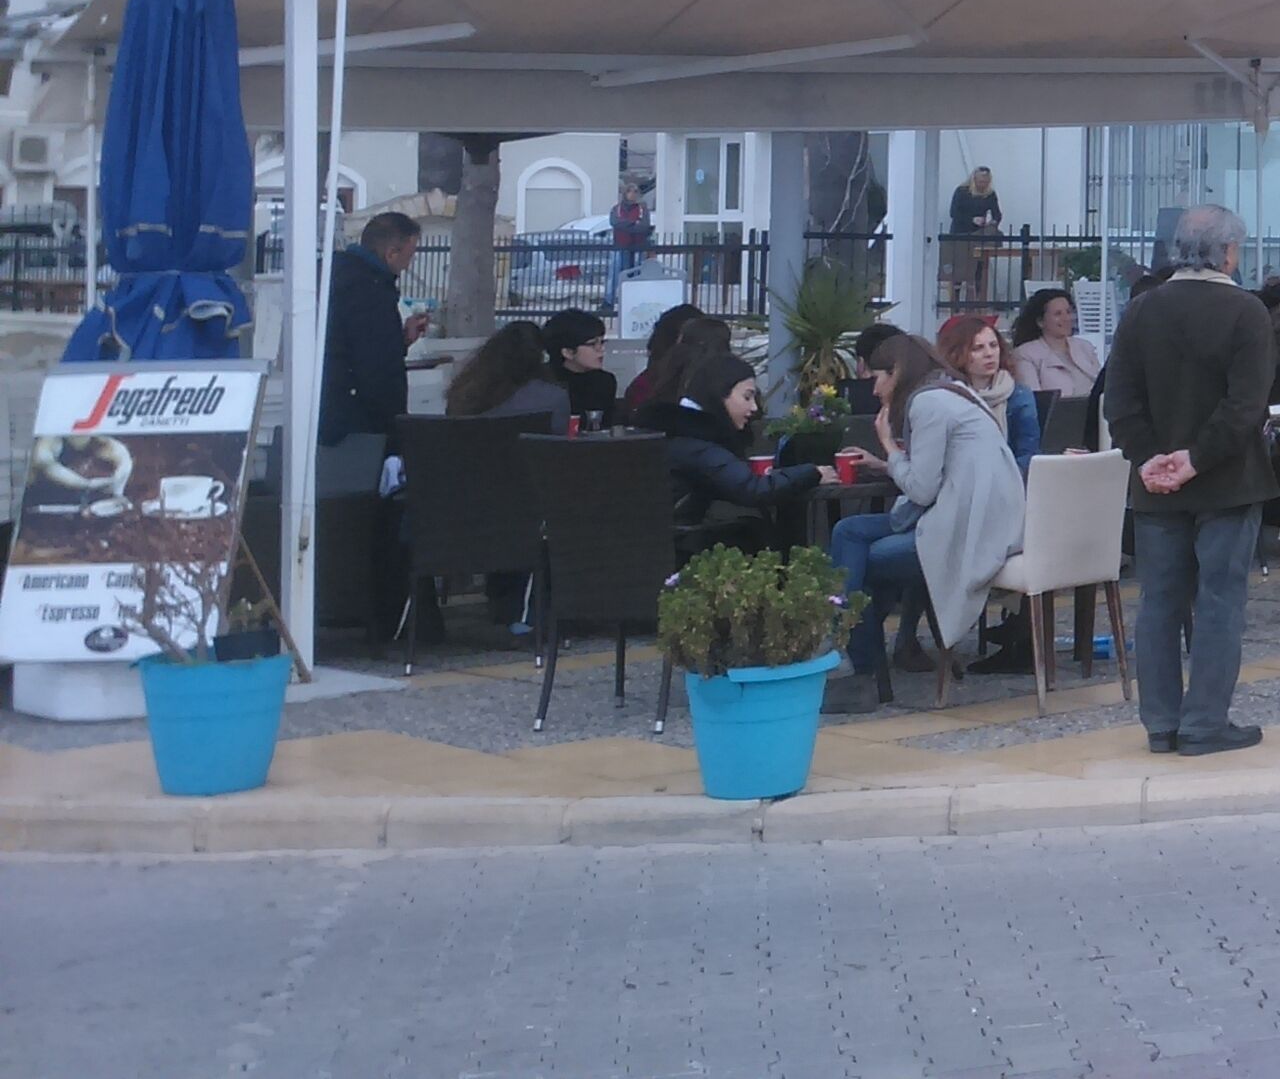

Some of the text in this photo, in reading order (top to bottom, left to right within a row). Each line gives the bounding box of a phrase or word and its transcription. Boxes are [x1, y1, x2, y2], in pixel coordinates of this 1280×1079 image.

[72, 372, 225, 431] Segafredo
[22, 573, 89, 589] Americano
[41, 604, 101, 622] Espresso
